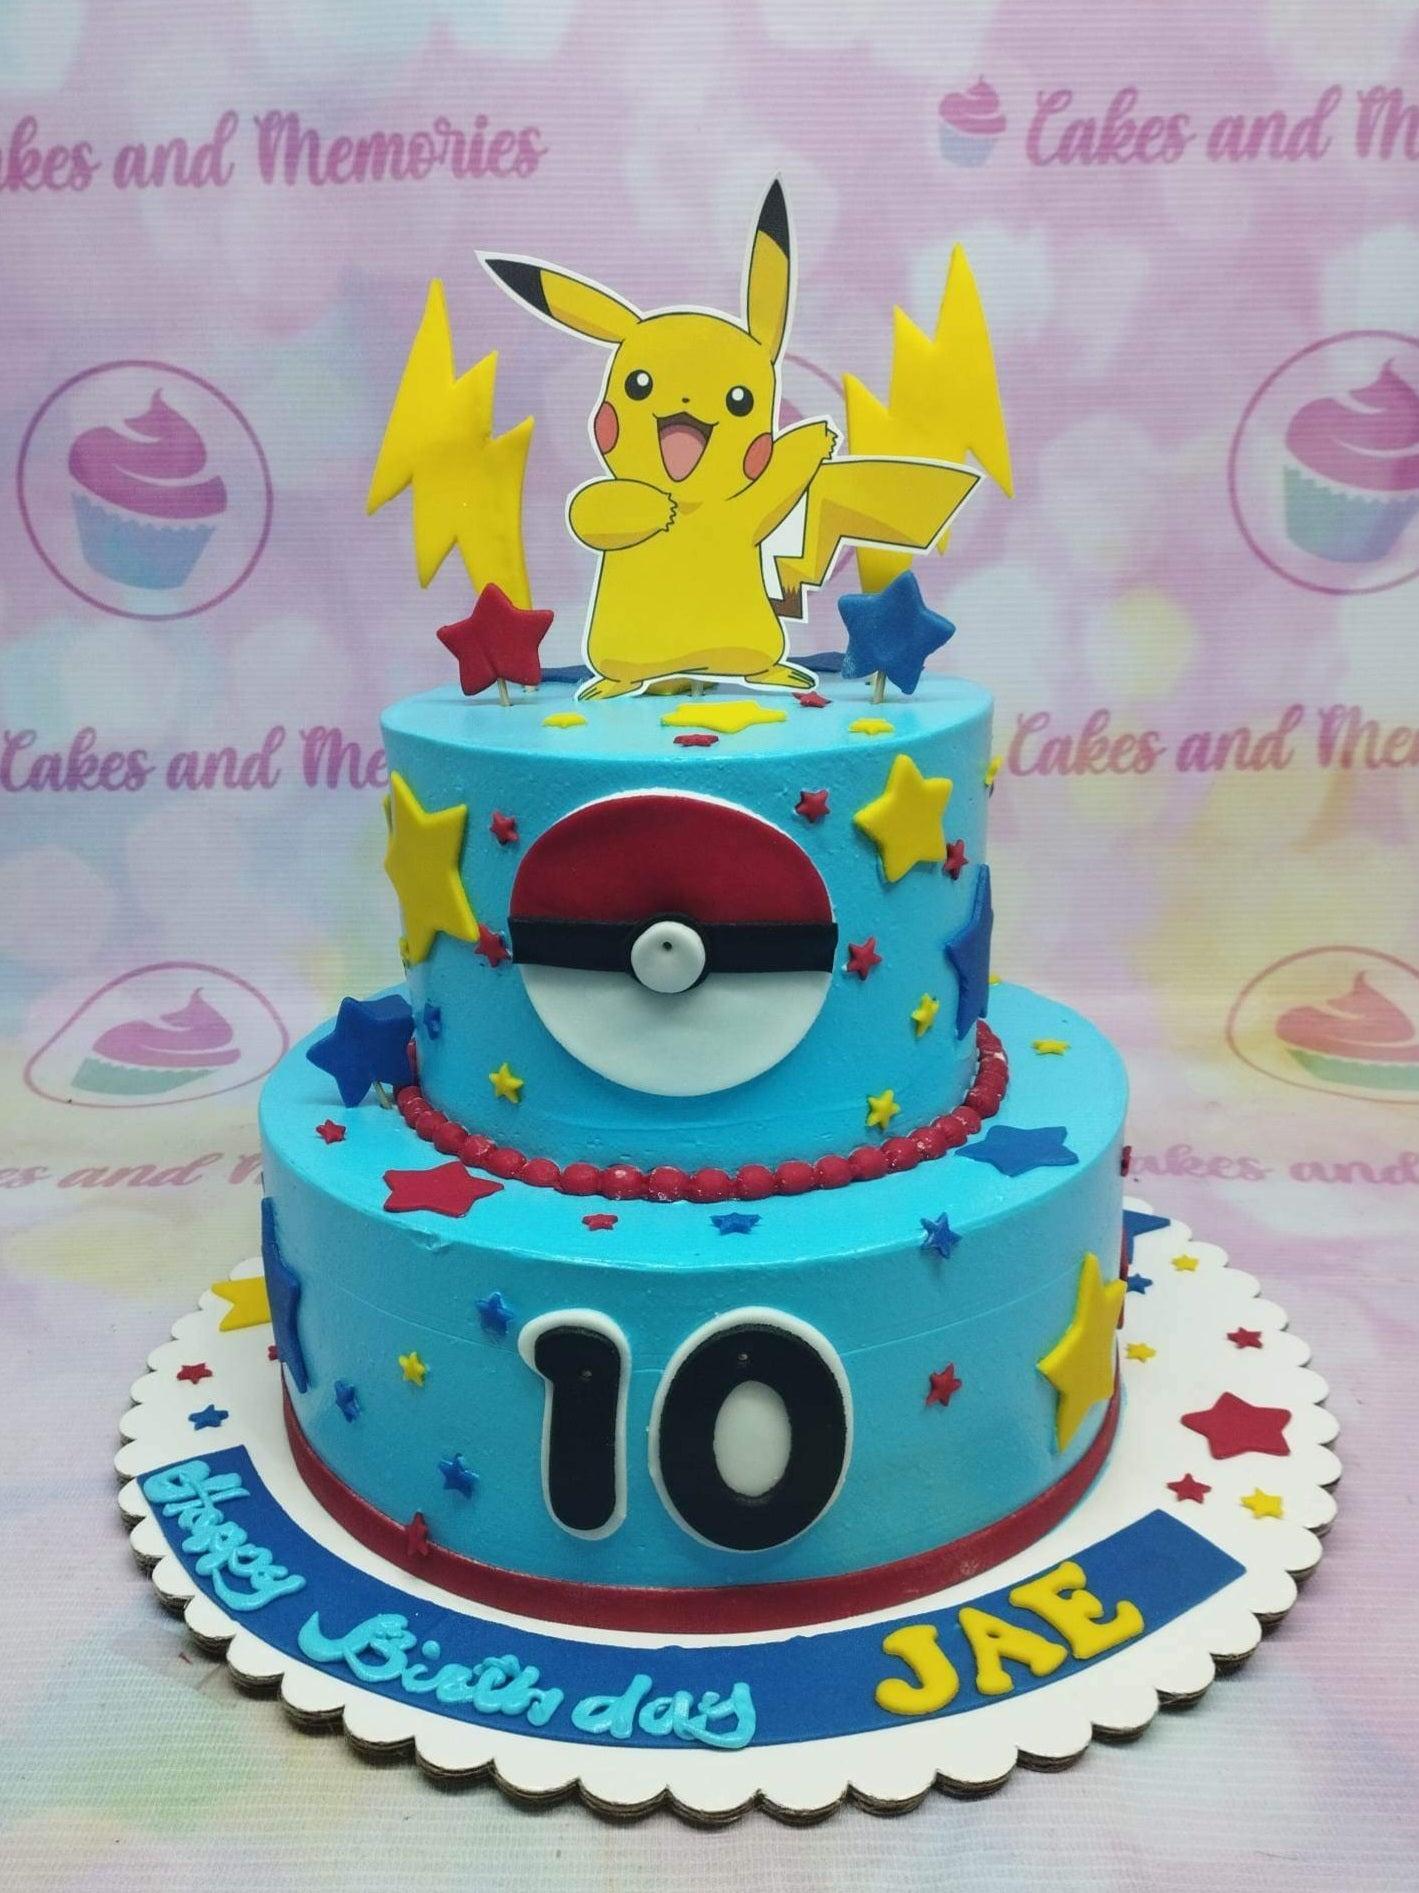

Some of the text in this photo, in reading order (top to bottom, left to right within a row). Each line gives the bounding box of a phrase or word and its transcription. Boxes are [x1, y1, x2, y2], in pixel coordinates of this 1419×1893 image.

[113, 110, 239, 188] and
[254, 109, 548, 187] Memories
[1025, 86, 1197, 167] Cakes
[1206, 84, 1342, 163] and
[1, 726, 156, 792] Cakes
[166, 725, 286, 790] and
[1008, 709, 1167, 777] Cakes
[1175, 704, 1304, 773] and
[56, 1152, 225, 1188] and
[1289, 1151, 1419, 1185] and
[518, 1306, 854, 1552] 10
[875, 1561, 1145, 1716] JAE
